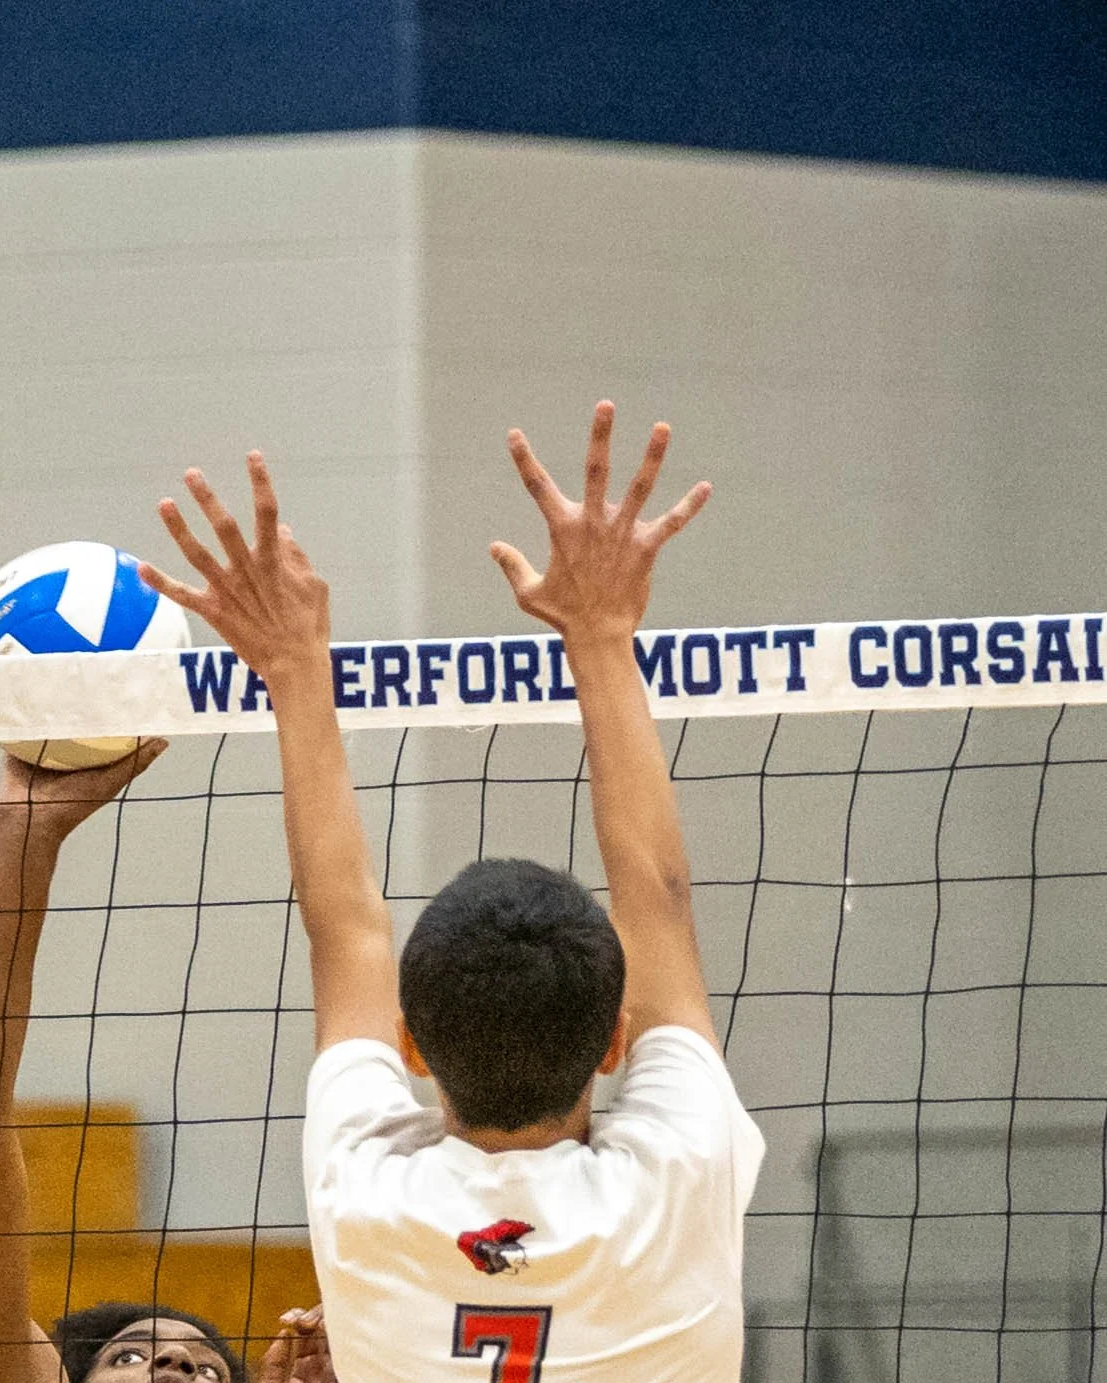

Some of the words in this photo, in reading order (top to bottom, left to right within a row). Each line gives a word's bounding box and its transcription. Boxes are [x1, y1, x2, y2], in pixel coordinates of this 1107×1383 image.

[180, 640, 577, 713] WERFOR
[632, 628, 815, 697] MOTT
[848, 618, 1104, 688] CORSAI
